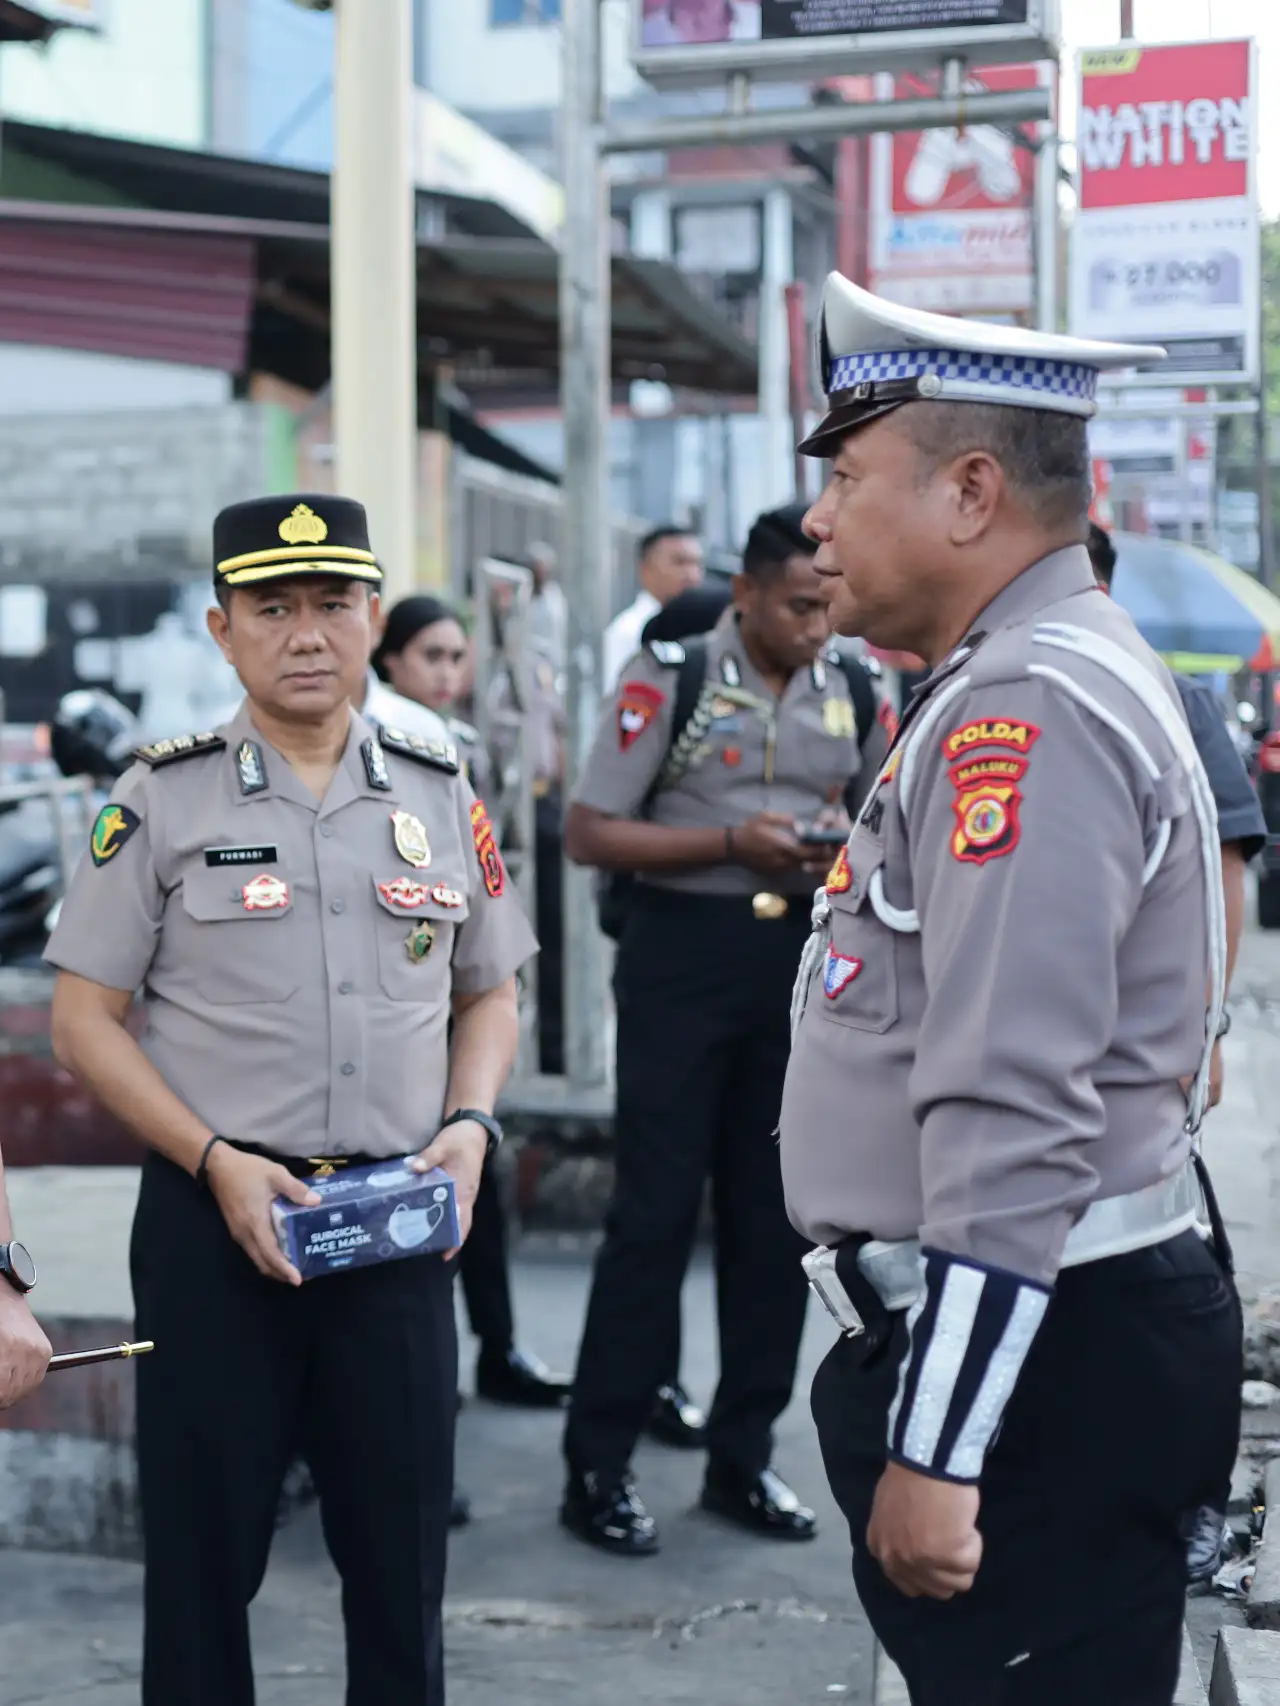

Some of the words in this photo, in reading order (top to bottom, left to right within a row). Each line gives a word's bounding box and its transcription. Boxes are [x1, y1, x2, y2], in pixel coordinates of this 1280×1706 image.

[1081, 97, 1249, 134] NATION
[1082, 127, 1248, 171] WHITE
[949, 723, 1027, 751] POLDA
[958, 760, 1019, 779] MALUKU
[305, 1241, 337, 1255] FACE
[338, 1233, 372, 1249] MASK
[311, 1224, 365, 1243] SURGICAL
